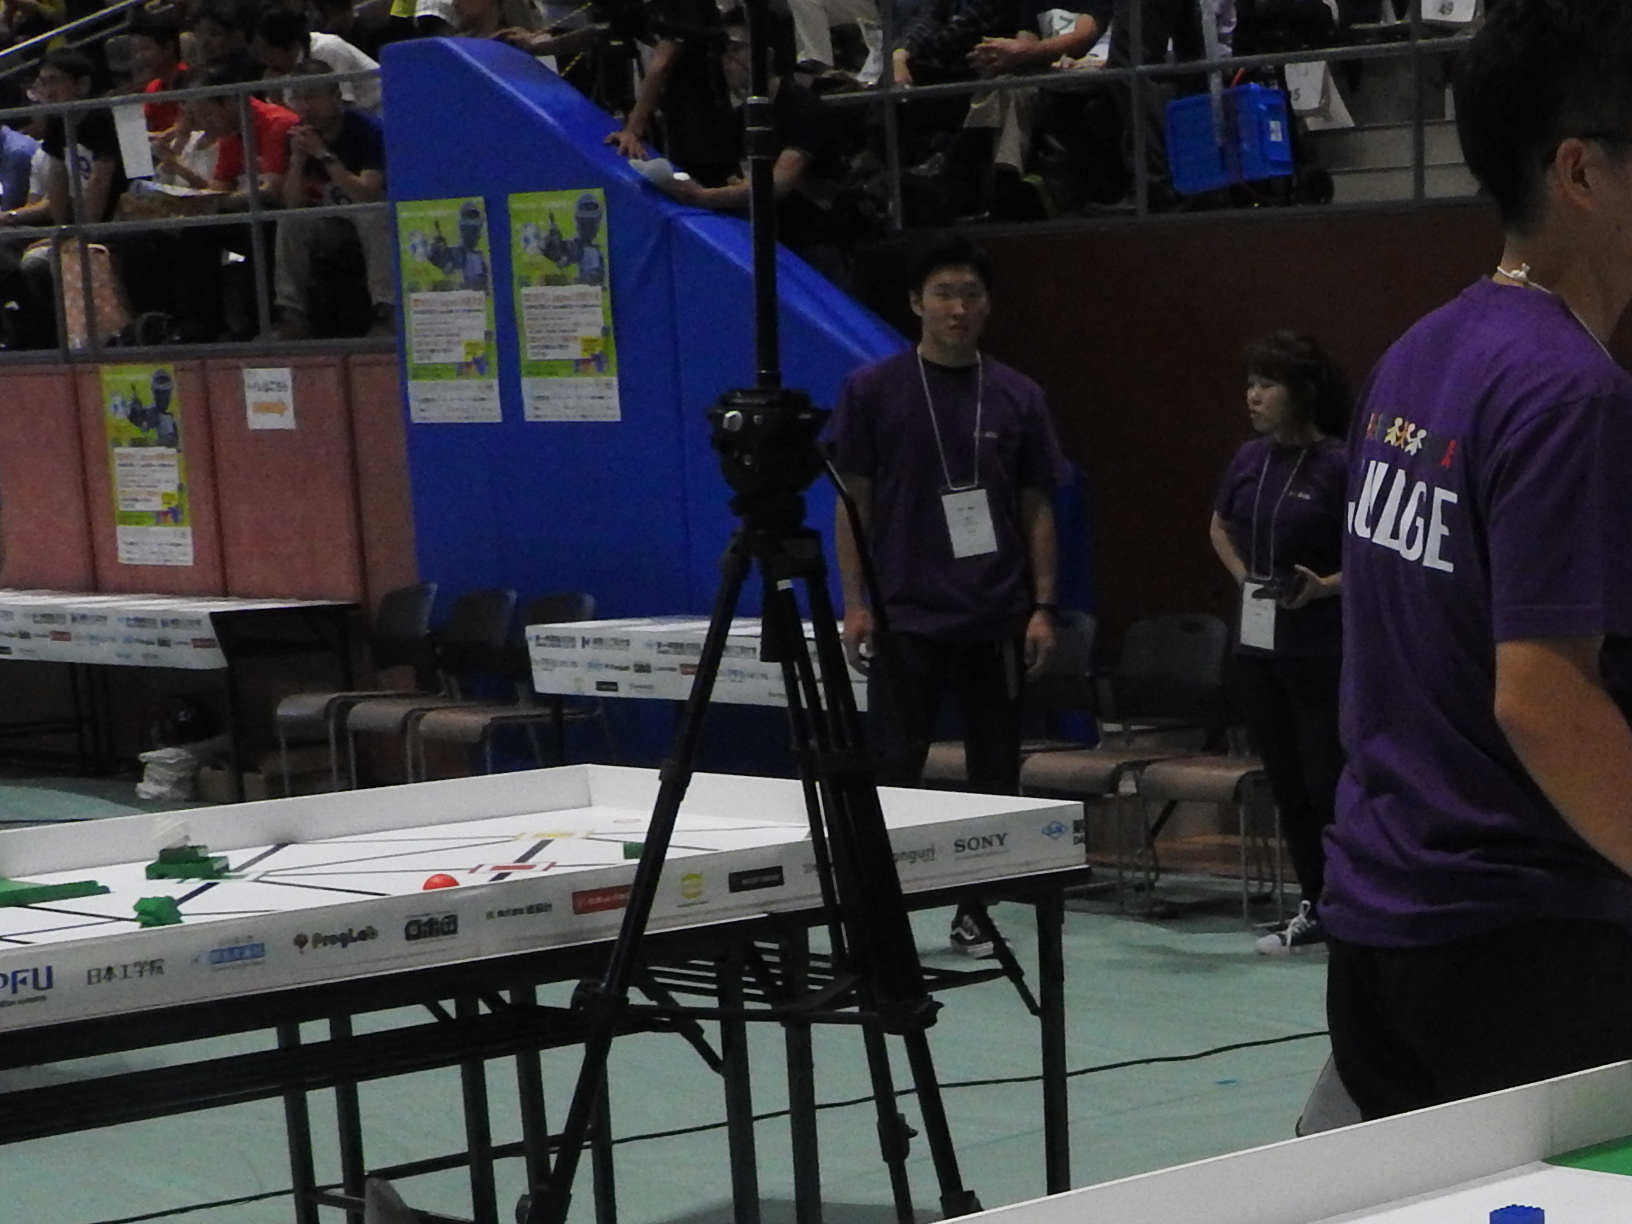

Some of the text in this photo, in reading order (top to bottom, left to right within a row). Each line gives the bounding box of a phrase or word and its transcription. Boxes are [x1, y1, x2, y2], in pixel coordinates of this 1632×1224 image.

[892, 842, 936, 864] onguri
[953, 832, 1010, 854] SONY
[86, 957, 166, 986] 日本工学院
